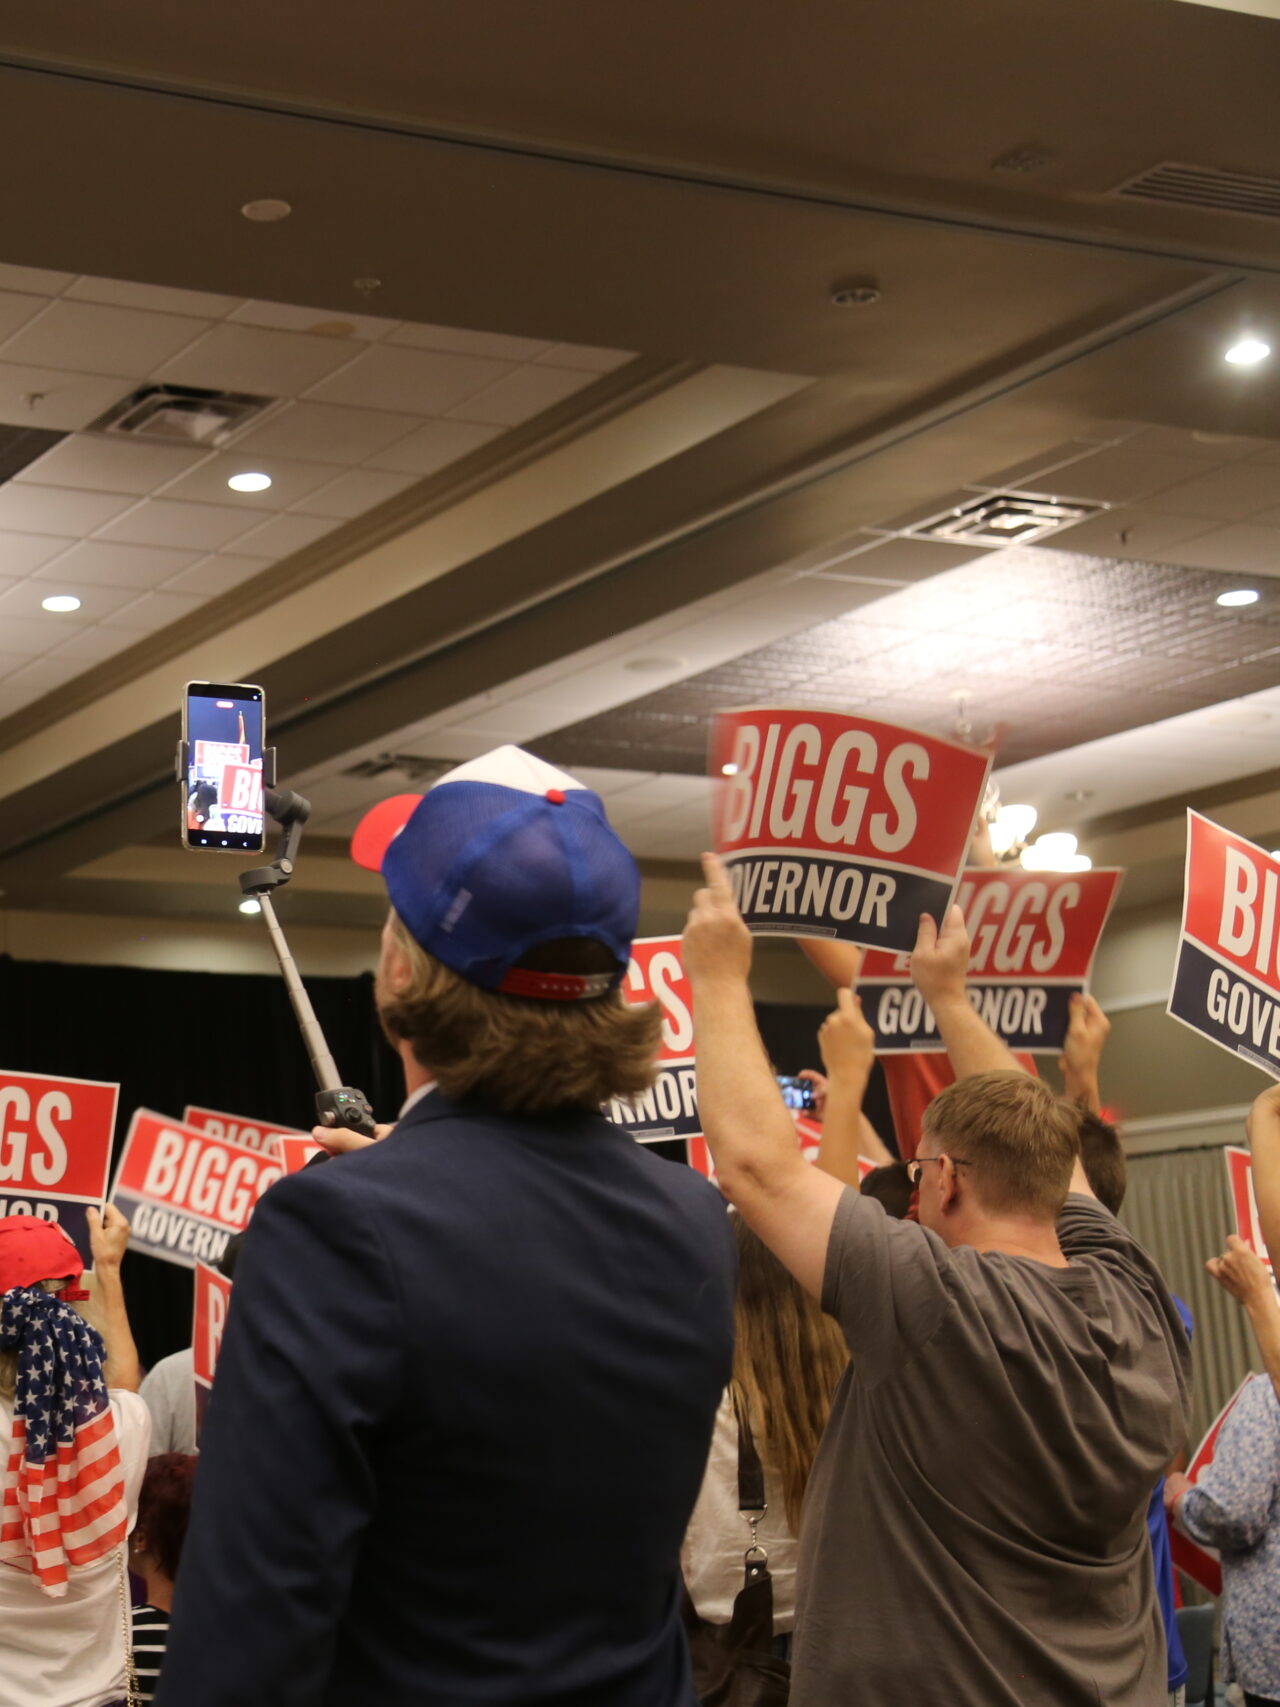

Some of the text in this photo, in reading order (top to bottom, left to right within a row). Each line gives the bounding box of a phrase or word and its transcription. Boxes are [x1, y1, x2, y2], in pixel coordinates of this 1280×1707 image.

[722, 722, 930, 854] BIGGS
[729, 861, 897, 928] OVERNOR
[1217, 845, 1280, 981] BI
[131, 1203, 231, 1261] GOVERN
